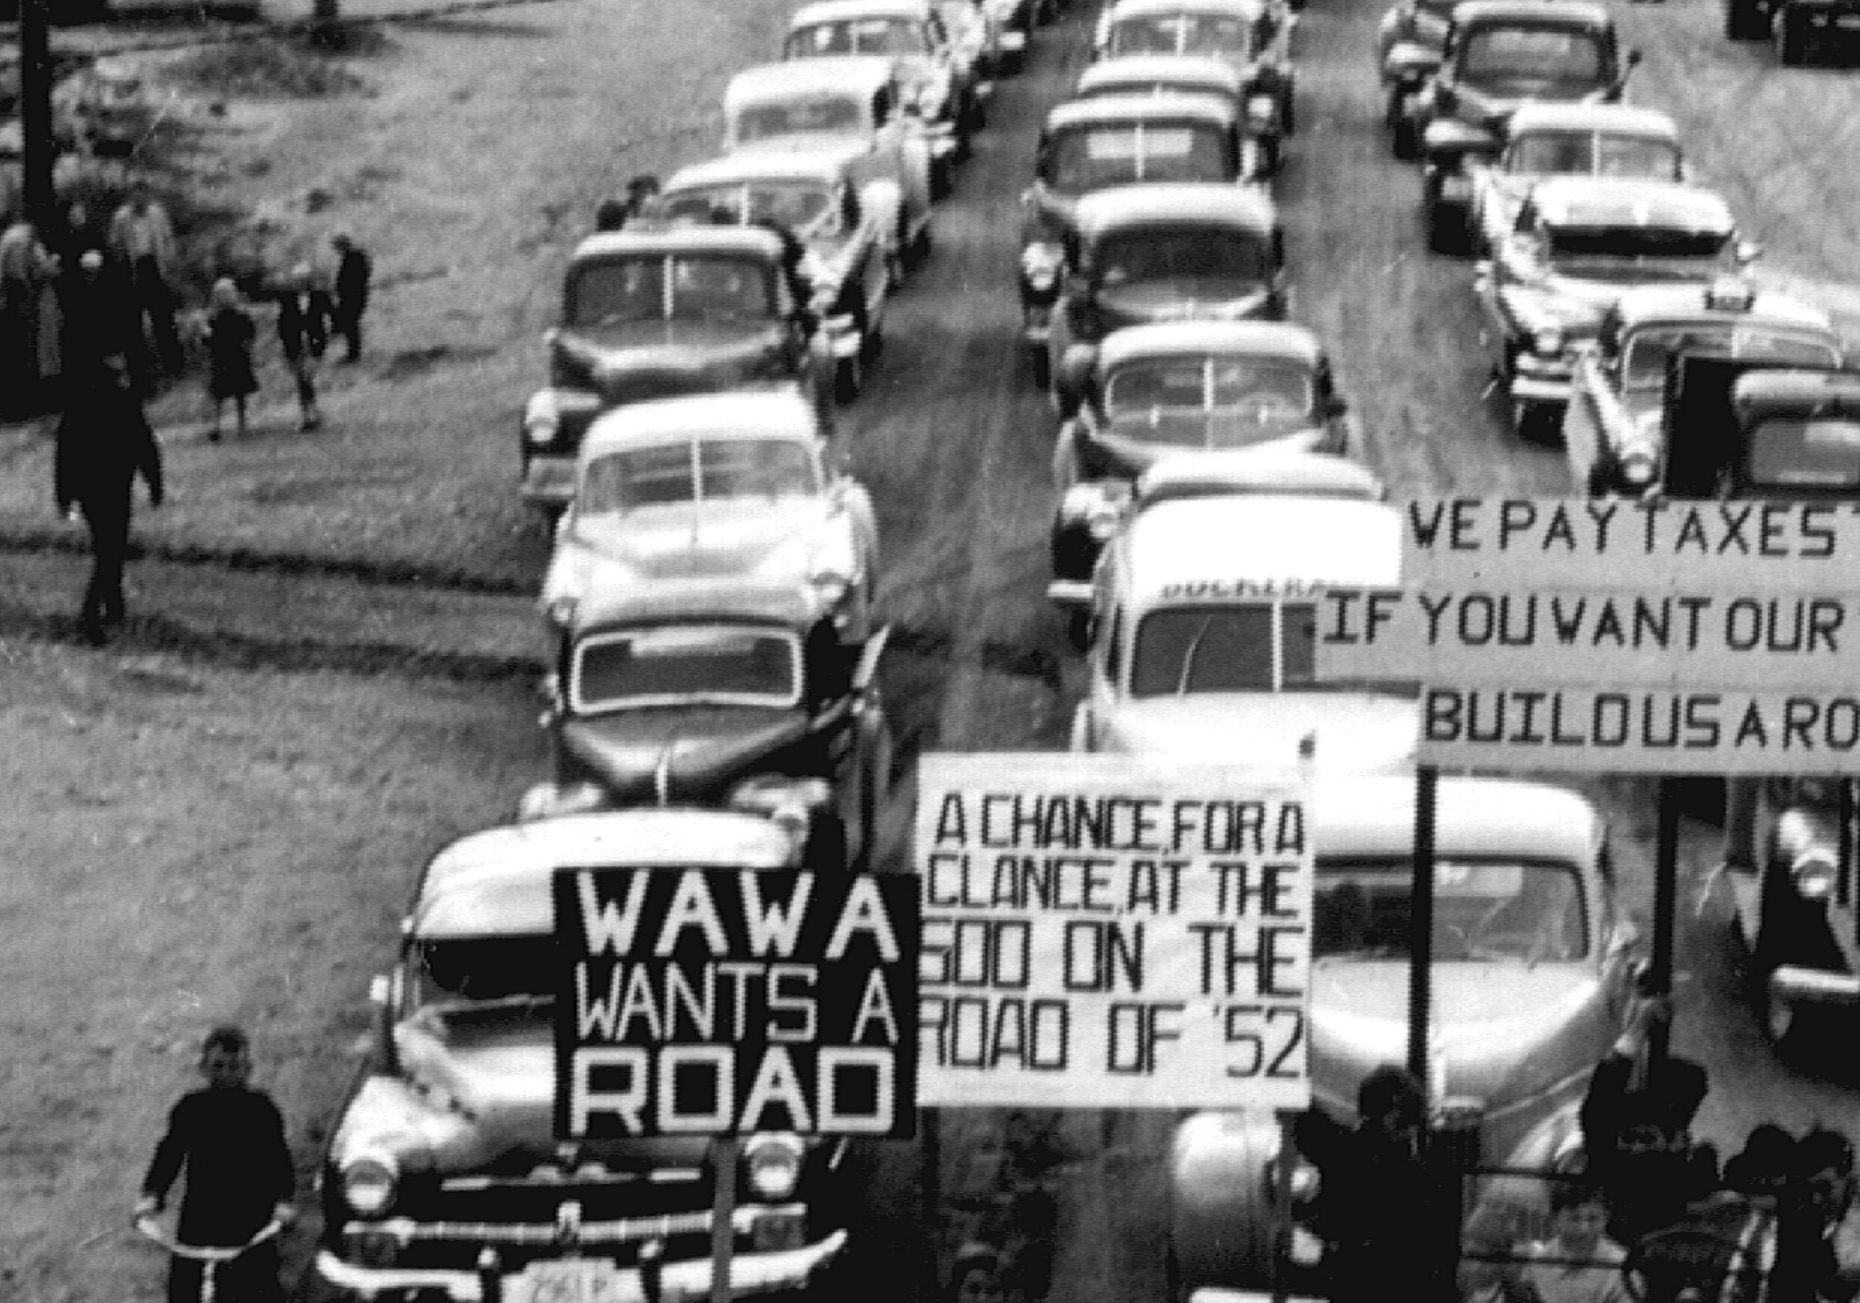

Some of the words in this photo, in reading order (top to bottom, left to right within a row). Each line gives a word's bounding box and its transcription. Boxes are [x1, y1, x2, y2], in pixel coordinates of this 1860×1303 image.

[1409, 499, 1483, 550] WE
[1498, 499, 1618, 554] PAY
[1635, 500, 1835, 557] TAXES
[1323, 590, 1403, 645] IF
[1417, 591, 1537, 646] YOU
[1551, 595, 1711, 652] WANT
[1725, 598, 1844, 653] OUR
[1425, 689, 1631, 747] BUILD
[1642, 695, 1721, 748] US
[1735, 699, 1768, 749] A
[935, 793, 967, 845] A
[1173, 800, 1265, 855] FOR
[1275, 801, 1304, 855] A
[576, 868, 902, 962] WAWA
[1127, 860, 1191, 915] AT
[1209, 861, 1301, 917] THE
[1064, 921, 1144, 993] ON
[1187, 923, 1305, 997] THE
[576, 961, 818, 1042] WANTS
[851, 968, 899, 1044] A
[1107, 1001, 1186, 1076] OF
[571, 1045, 896, 1136] ROAD
